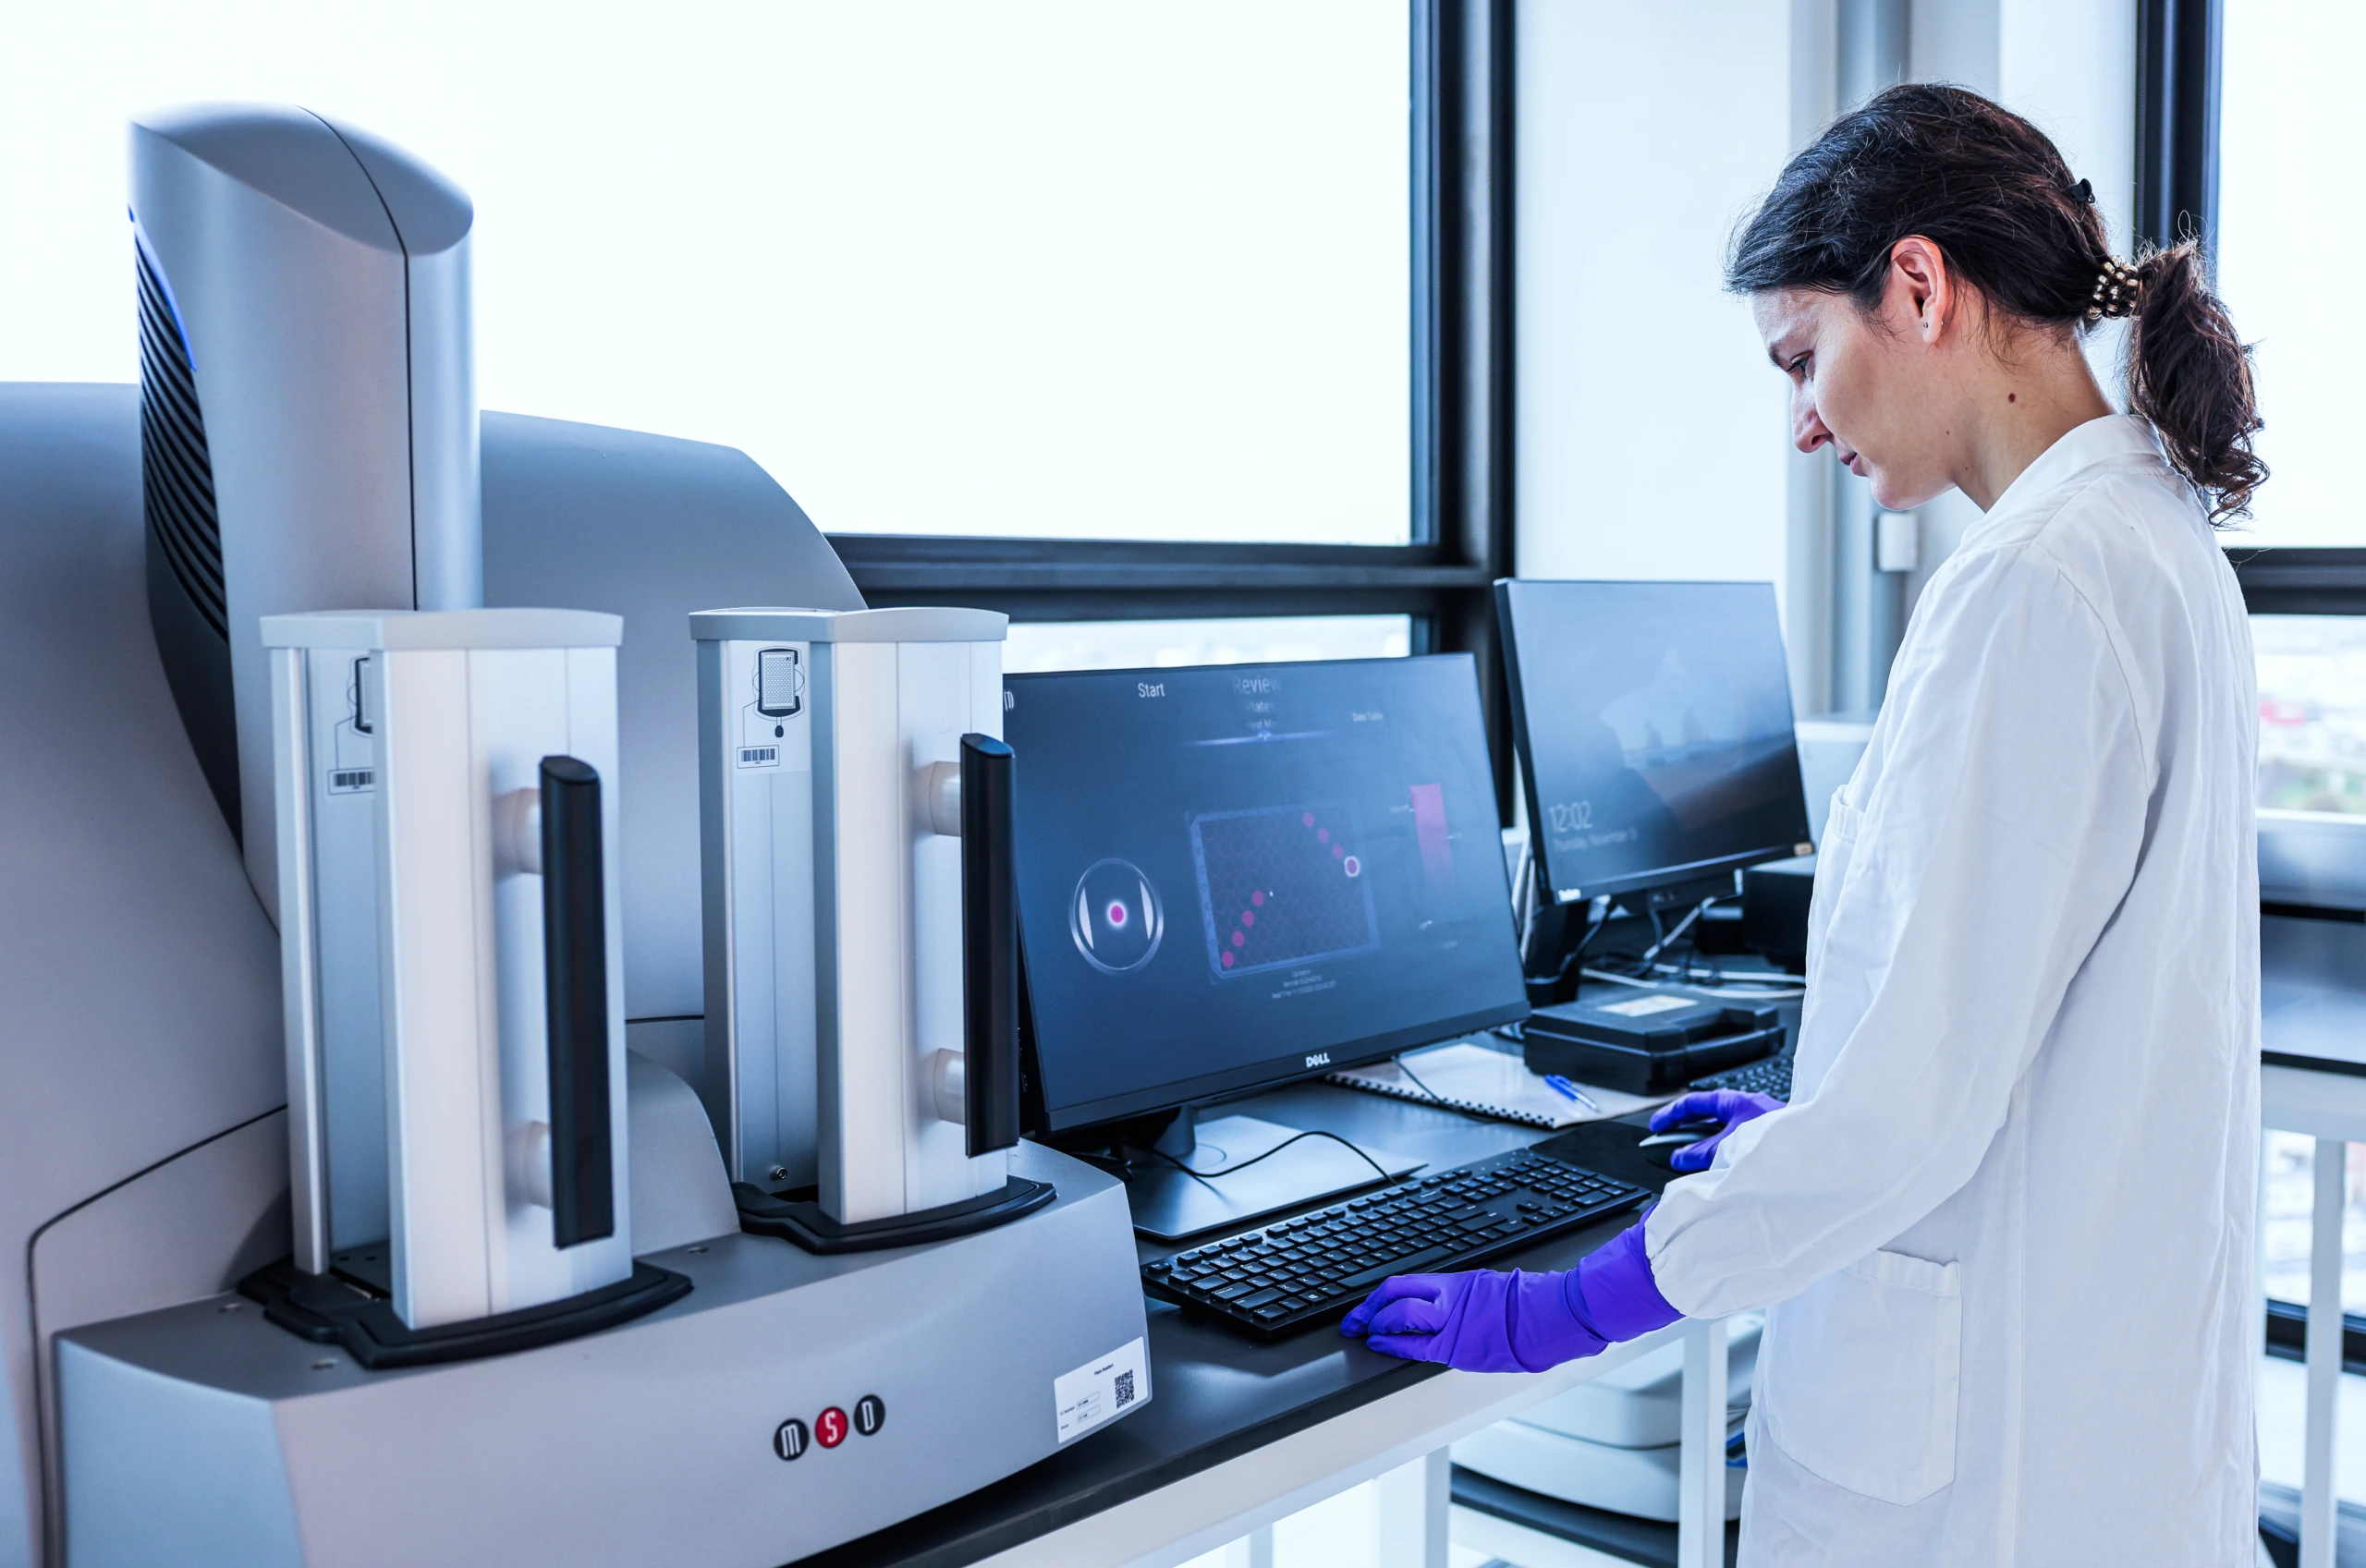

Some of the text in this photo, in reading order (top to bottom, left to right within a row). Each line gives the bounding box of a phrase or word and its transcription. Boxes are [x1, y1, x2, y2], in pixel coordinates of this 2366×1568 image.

[1138, 682, 1165, 699] Start
[1231, 675, 1282, 696] Review
[1305, 1052, 1331, 1068] DELL
